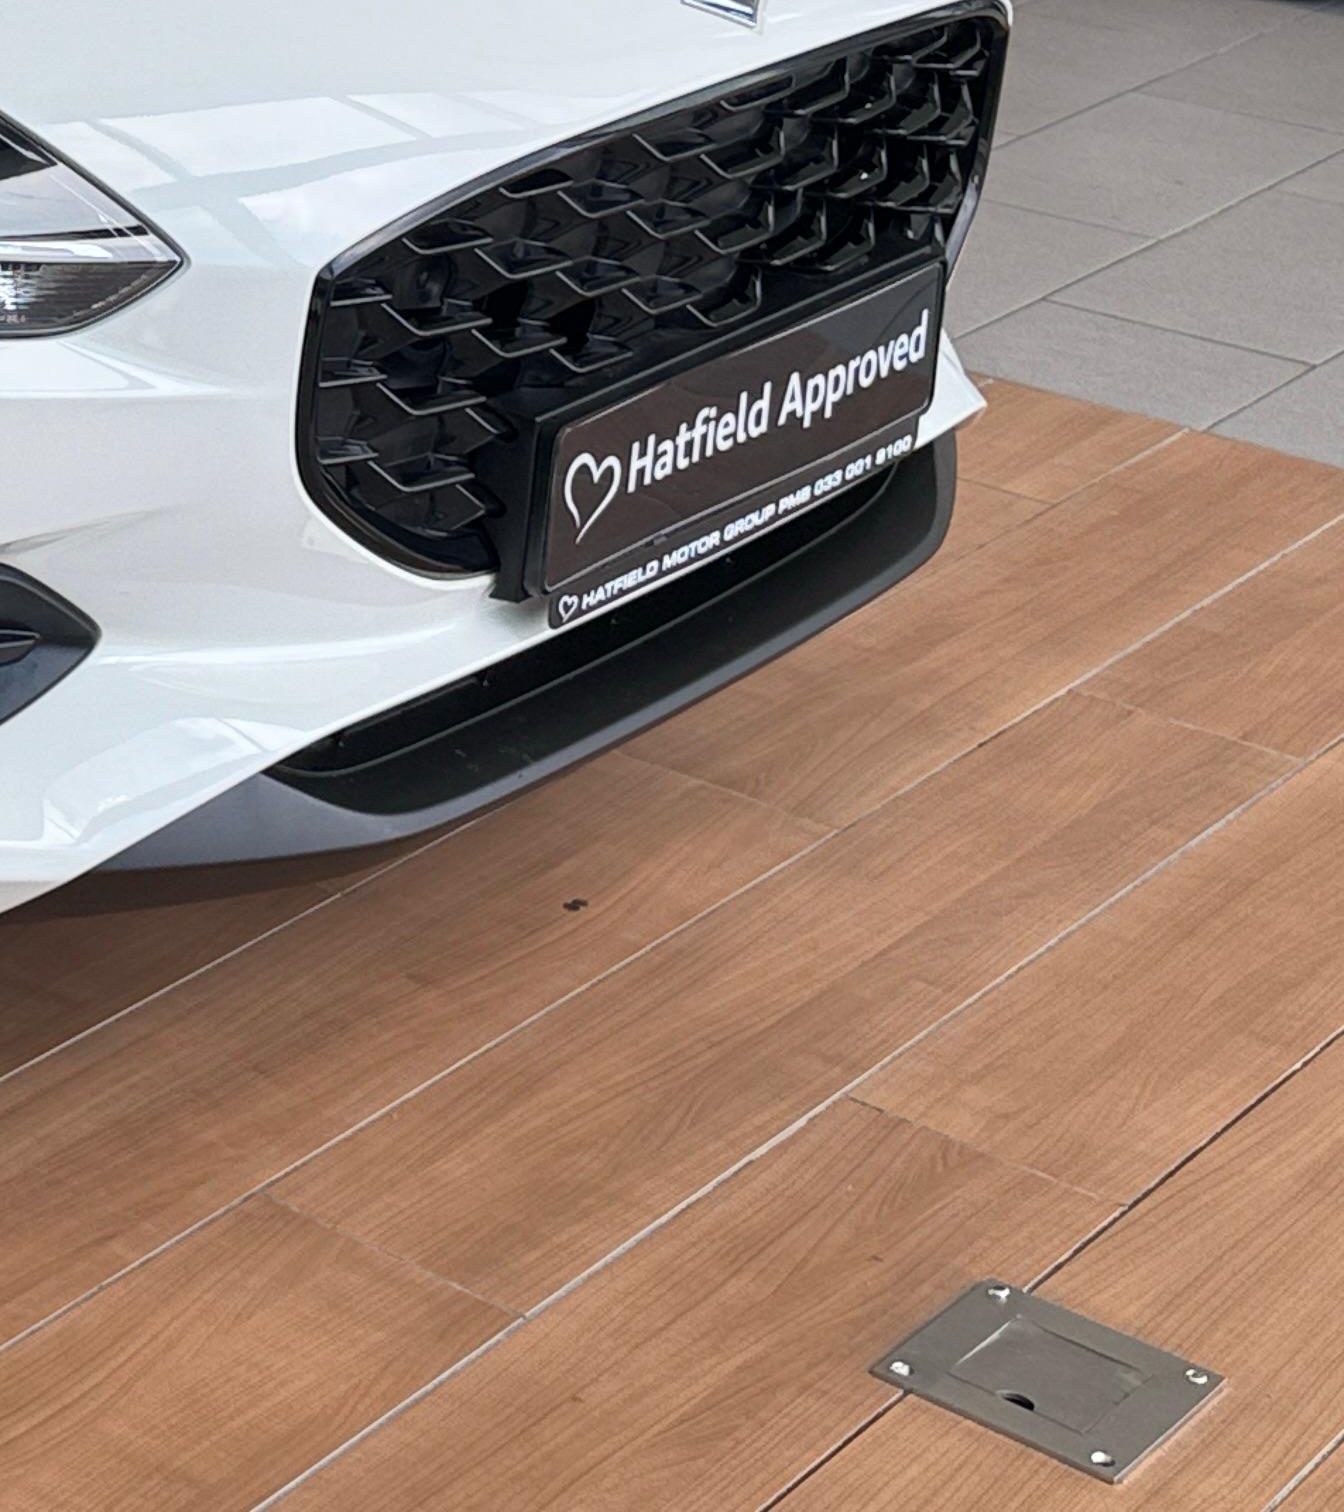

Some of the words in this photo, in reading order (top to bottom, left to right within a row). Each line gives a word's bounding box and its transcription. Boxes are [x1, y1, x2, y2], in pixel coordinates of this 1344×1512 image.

[627, 381, 772, 493] Hatfield
[777, 308, 929, 428] Approved
[581, 560, 660, 610] HATFIELD
[662, 530, 721, 570] MOTOR
[723, 502, 776, 541] GROUP
[778, 484, 812, 514] PMB
[814, 469, 843, 496] 033
